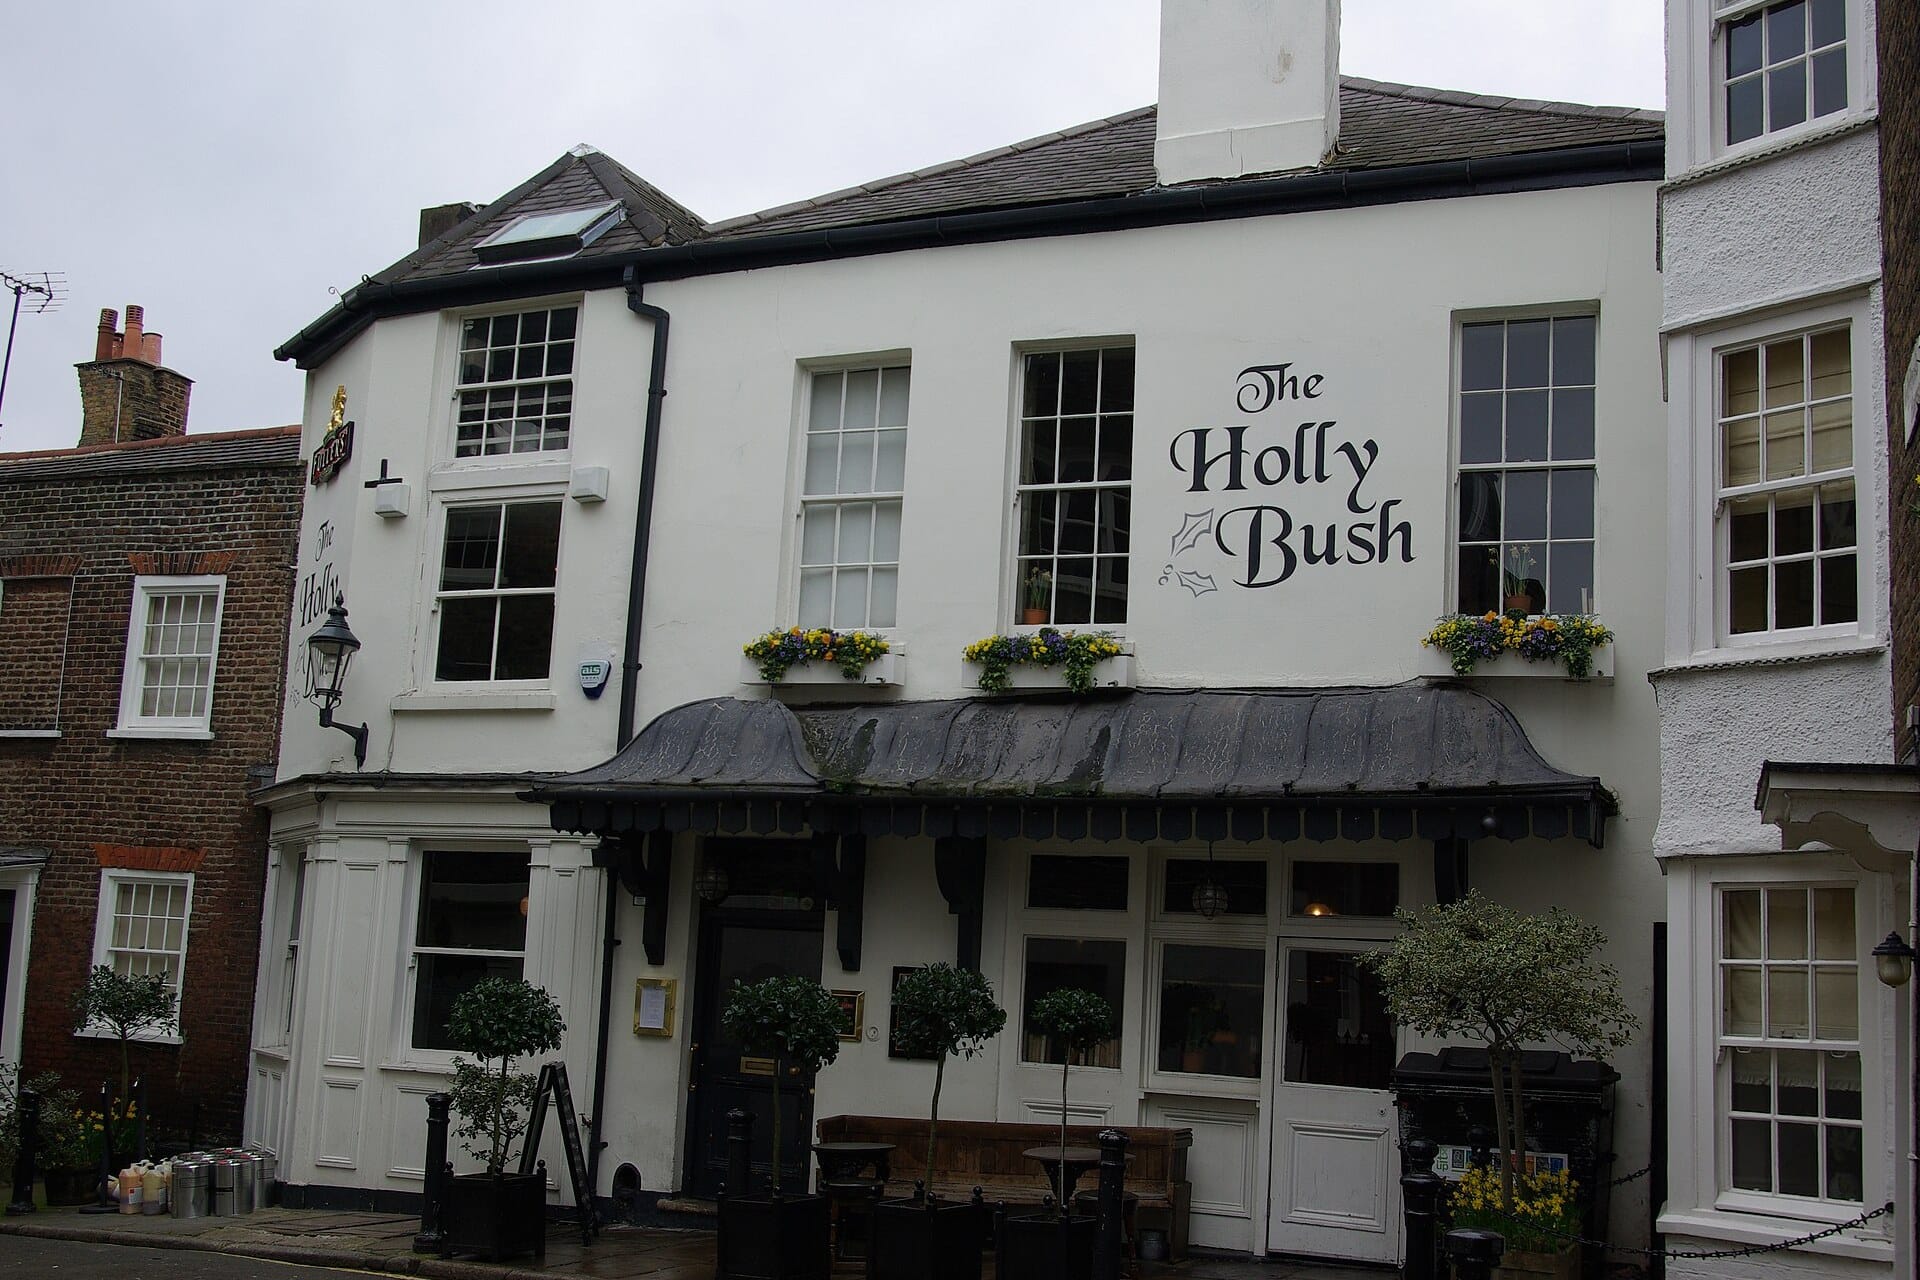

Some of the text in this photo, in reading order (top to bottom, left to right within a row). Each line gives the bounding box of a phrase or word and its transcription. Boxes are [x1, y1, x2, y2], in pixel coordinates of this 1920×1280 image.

[1236, 362, 1324, 413] The
[1170, 421, 1379, 514] Holly
[315, 519, 335, 562] The
[1215, 499, 1417, 588] Bush
